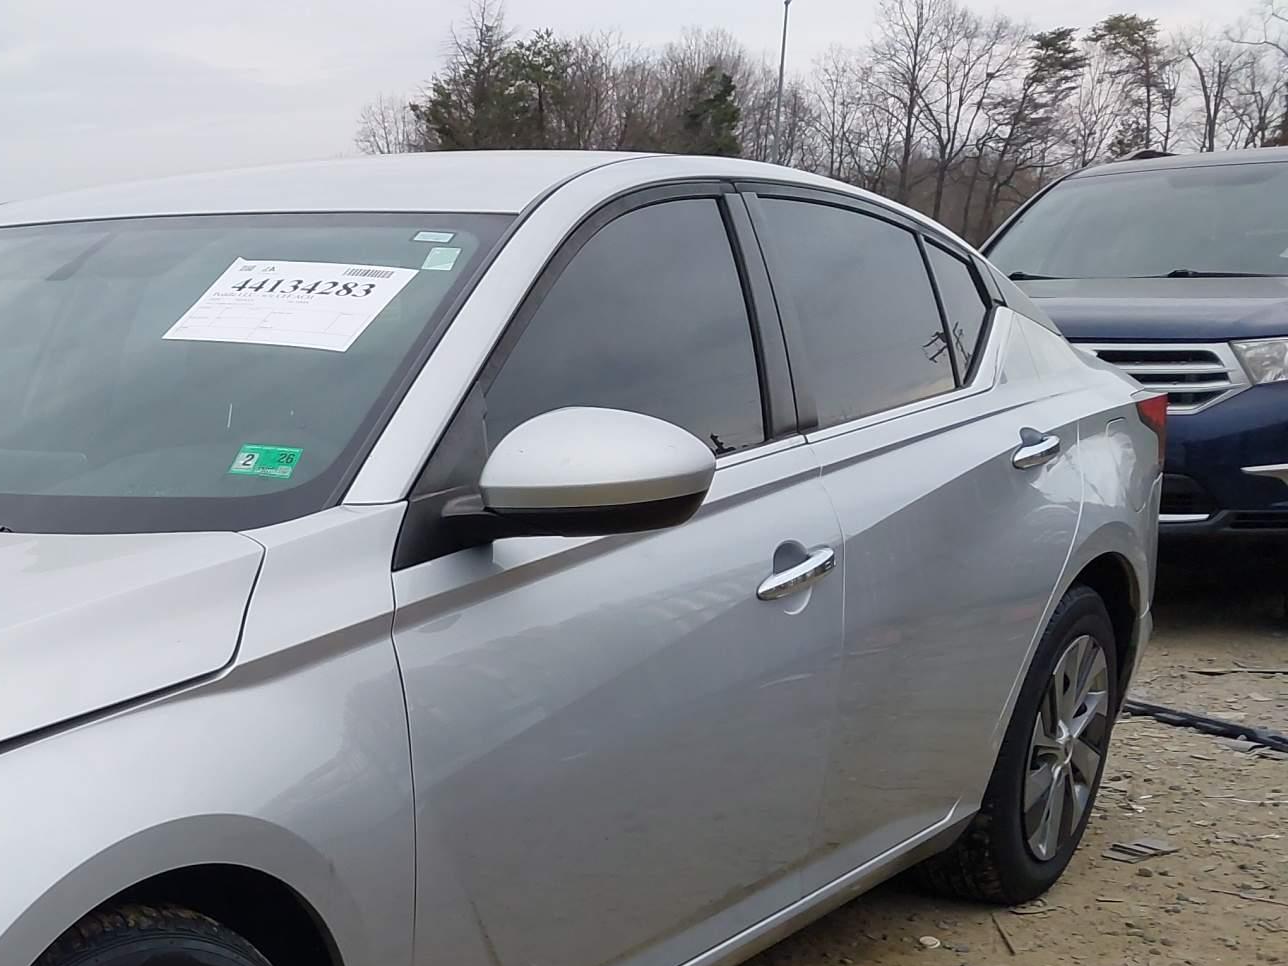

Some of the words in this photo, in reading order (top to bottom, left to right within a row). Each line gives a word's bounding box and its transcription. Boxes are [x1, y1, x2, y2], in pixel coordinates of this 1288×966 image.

[231, 278, 376, 298] 44134283
[242, 453, 255, 466] 2
[278, 453, 296, 464] 26
